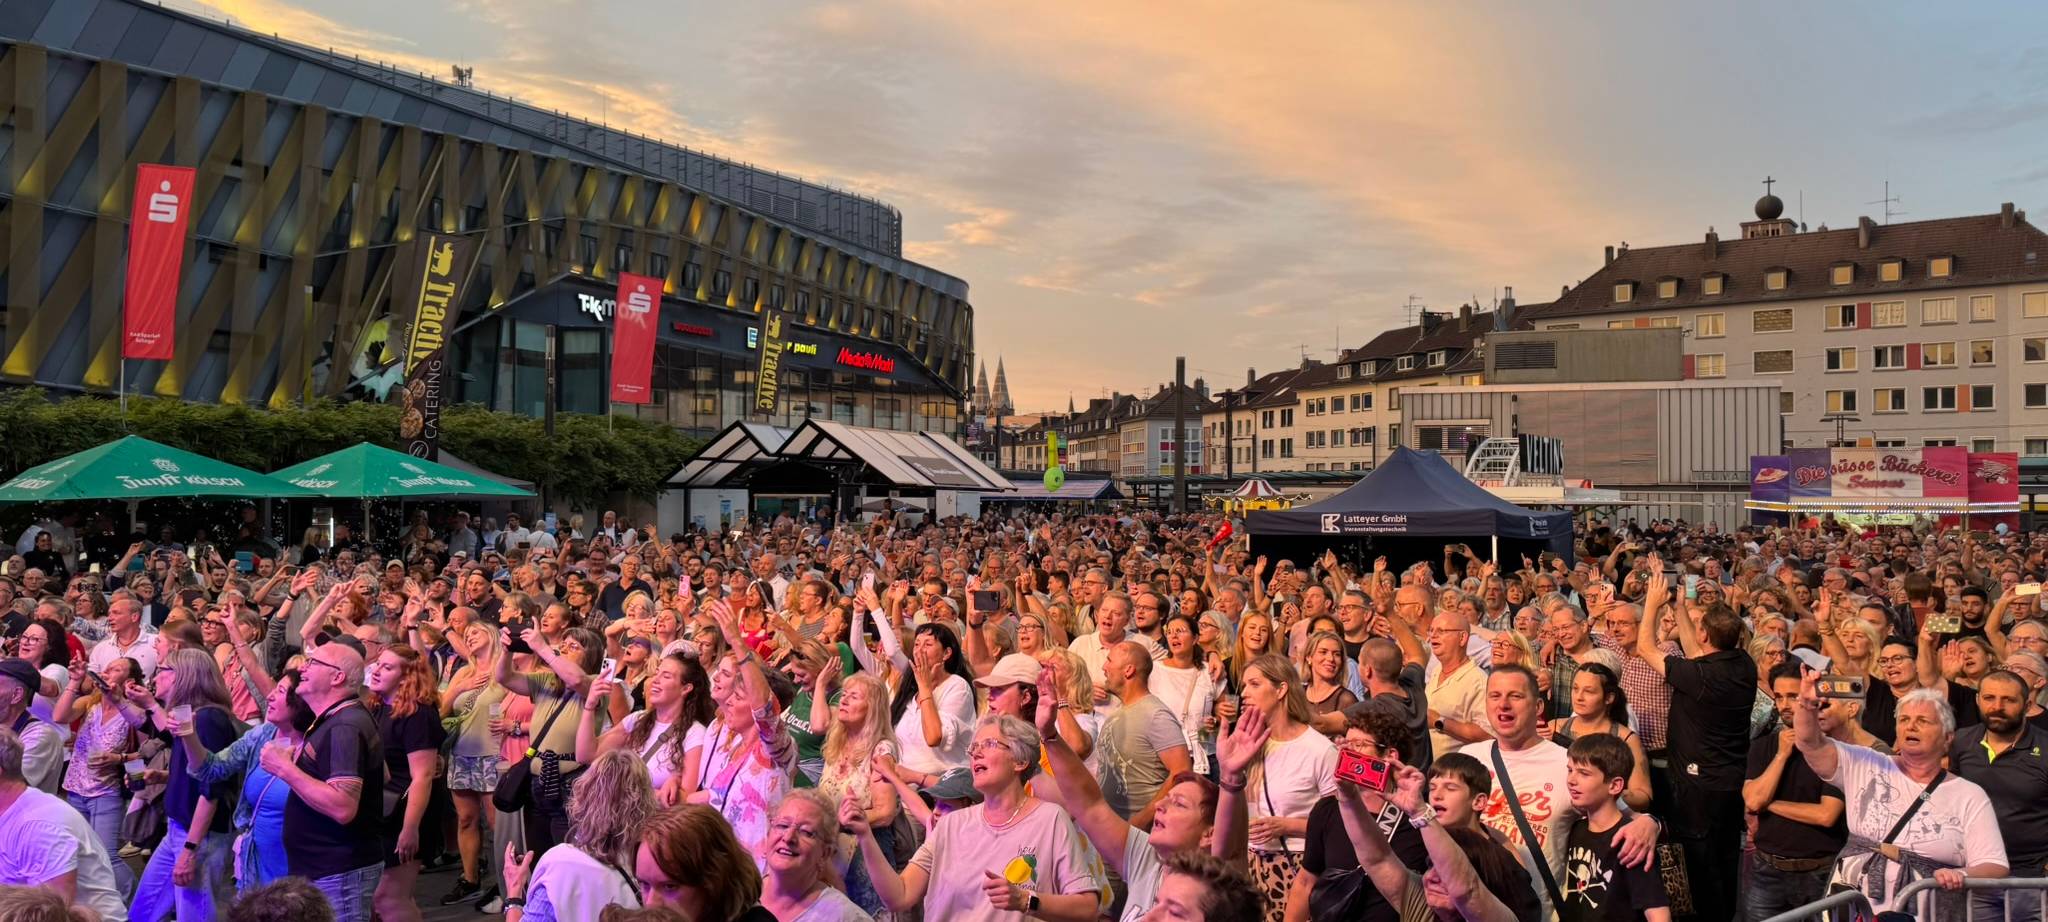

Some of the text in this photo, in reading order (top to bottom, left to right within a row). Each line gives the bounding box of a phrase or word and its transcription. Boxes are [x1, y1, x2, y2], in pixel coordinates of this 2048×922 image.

[759, 342, 784, 410] Tractive
[424, 360, 442, 439] CATERING
[1526, 433, 1565, 475] VELTINS
[1794, 454, 1962, 487] Die süsse Bäckerei
[1343, 514, 1408, 524] Latteyer GmbH
